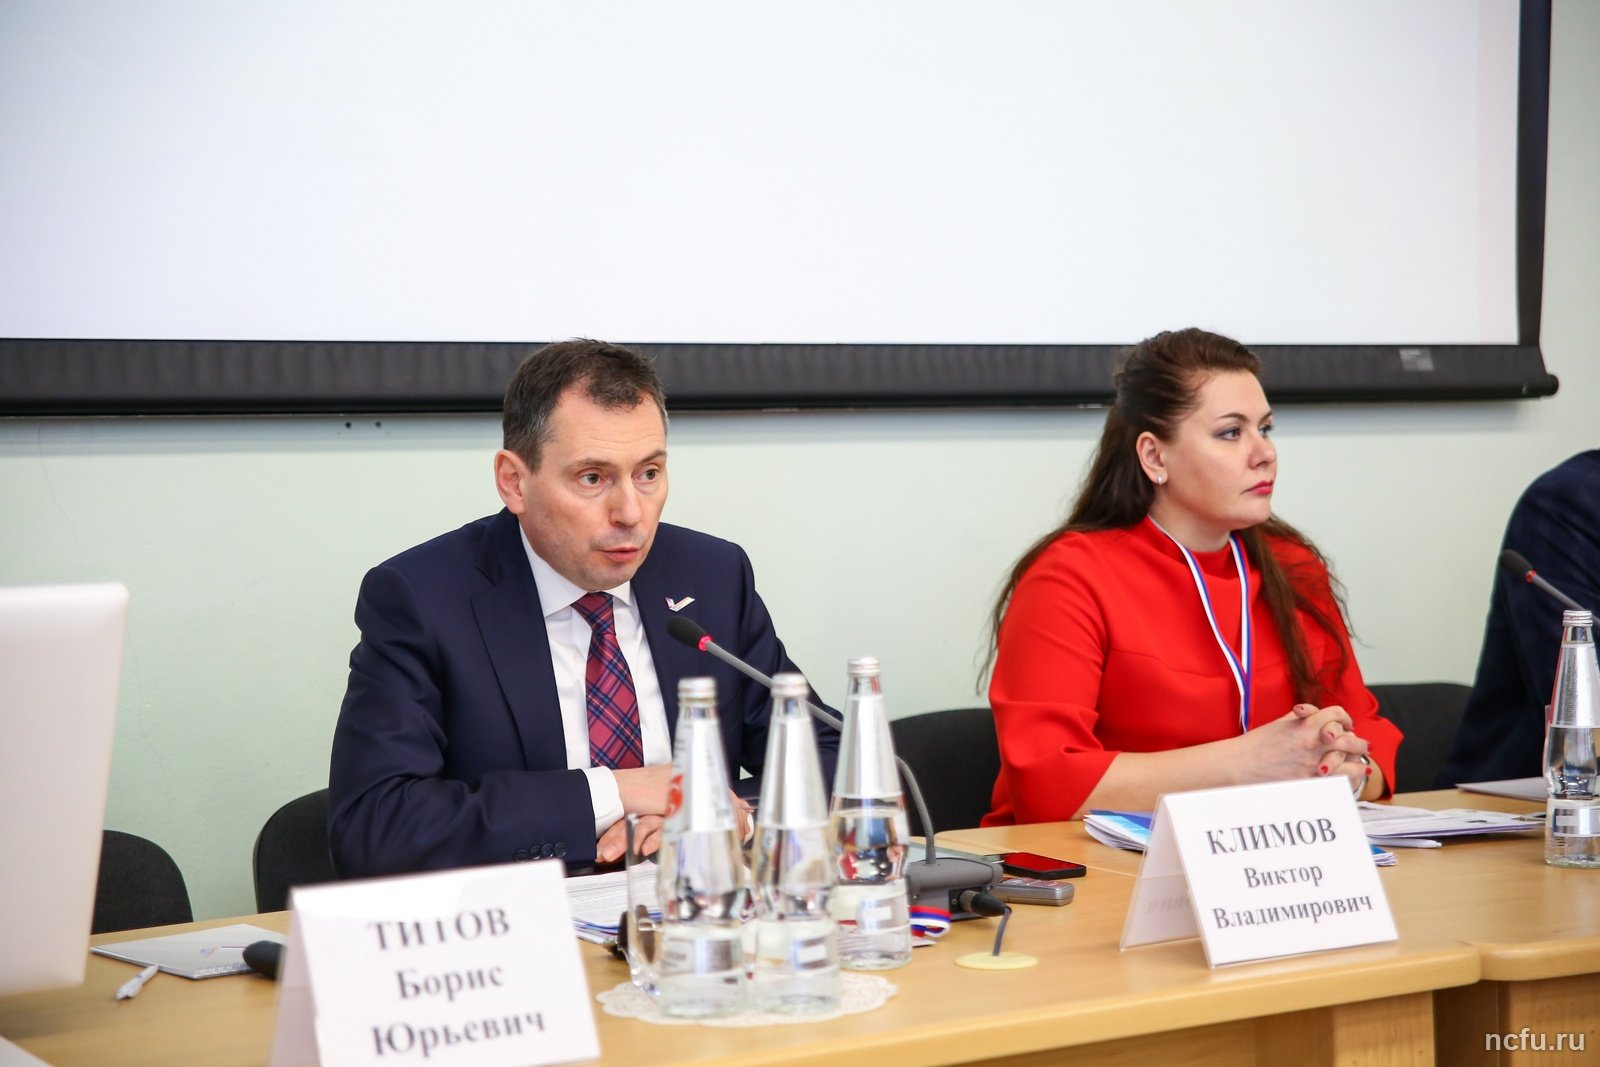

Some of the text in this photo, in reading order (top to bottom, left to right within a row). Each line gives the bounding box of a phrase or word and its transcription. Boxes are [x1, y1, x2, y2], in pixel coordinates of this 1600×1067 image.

[1206, 818, 1337, 855] КЛИМОВ
[1243, 865, 1323, 888] Виктор
[1213, 895, 1373, 929] Владимирович
[396, 965, 503, 1001] Борис
[371, 1011, 545, 1057] Юрьевич
